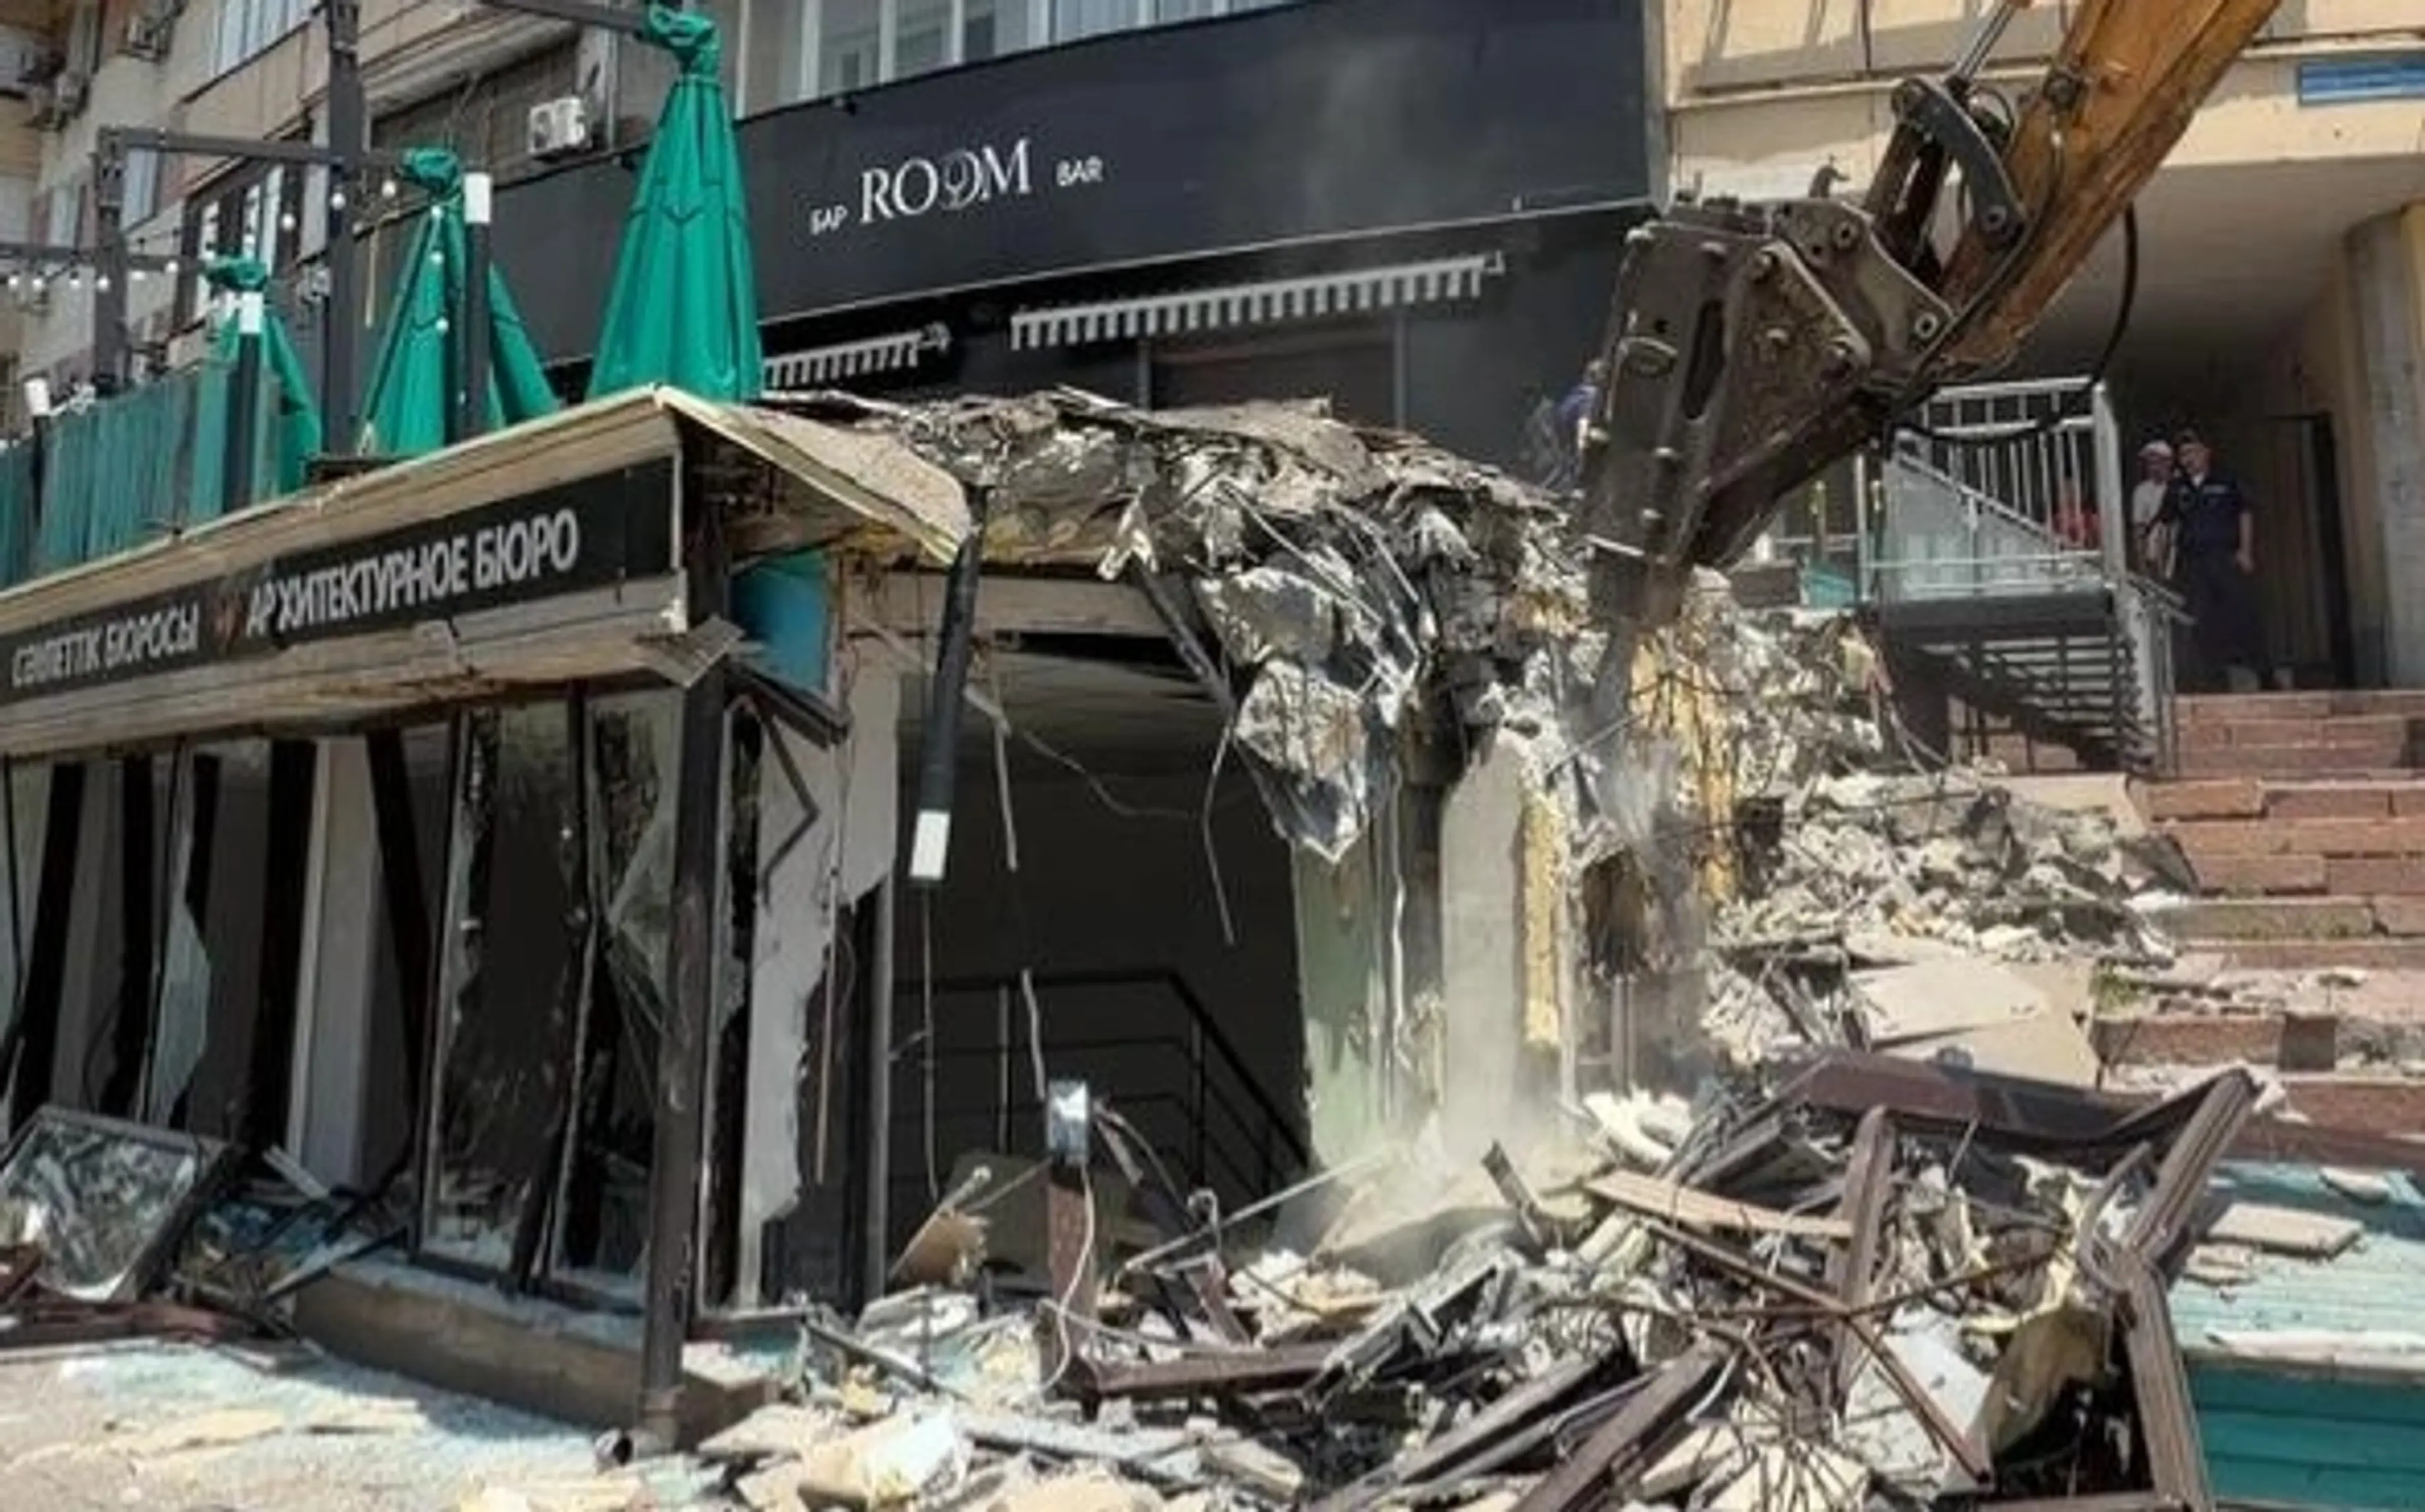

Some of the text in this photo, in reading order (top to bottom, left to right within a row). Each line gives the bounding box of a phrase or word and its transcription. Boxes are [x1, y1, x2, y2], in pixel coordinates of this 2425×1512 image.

[859, 137, 1031, 224] ROOM
[1057, 155, 1104, 188] BAR
[246, 533, 469, 638] АРХИТЕКТУРНОЕ
[475, 508, 579, 589] БЮРО
